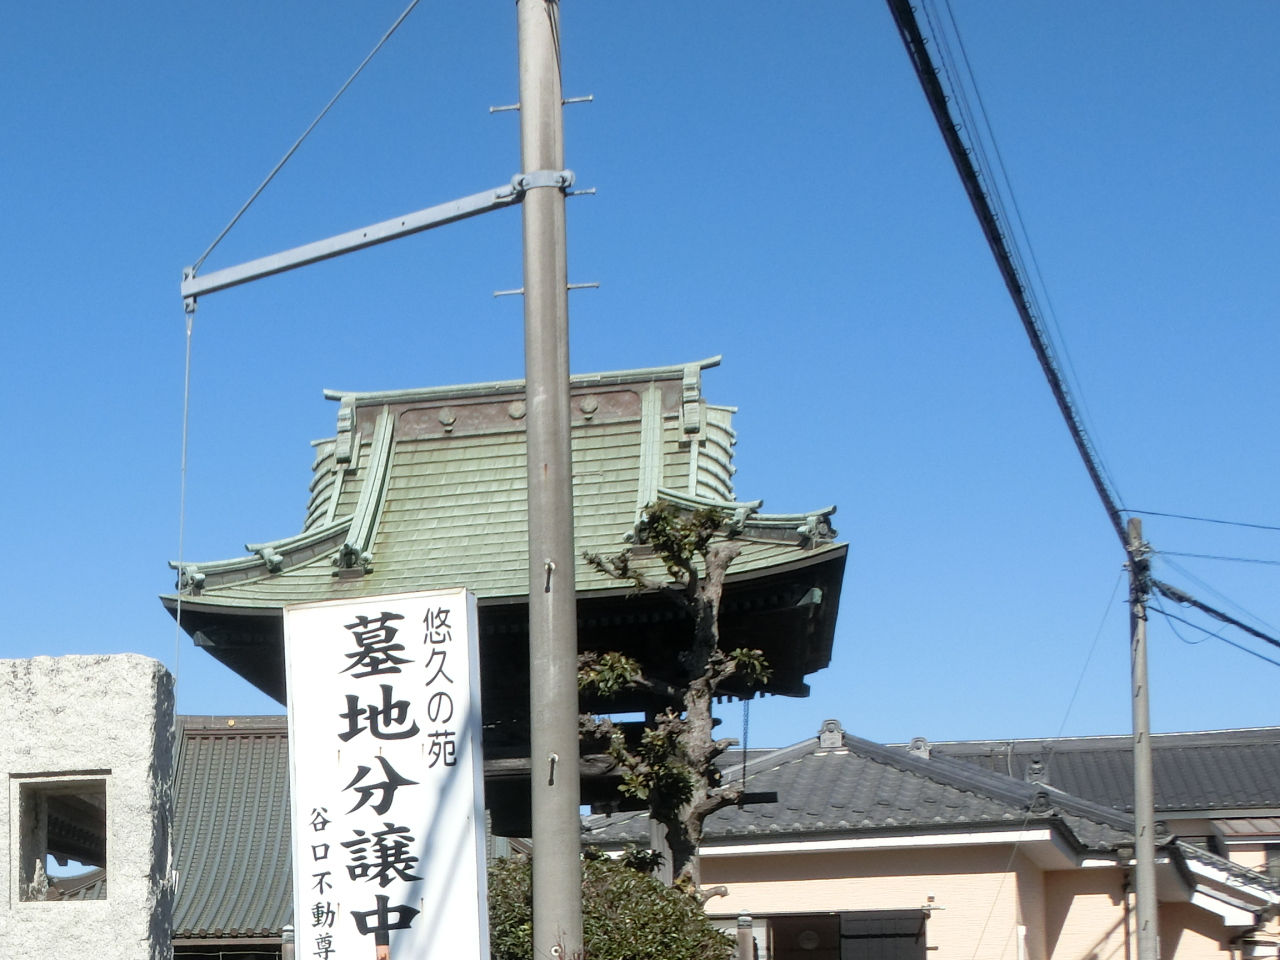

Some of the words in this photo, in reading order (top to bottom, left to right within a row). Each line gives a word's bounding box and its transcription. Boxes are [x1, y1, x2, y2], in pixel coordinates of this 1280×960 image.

[337, 611, 423, 946] 墓地分譲中
[423, 607, 457, 768] 悠久の苑
